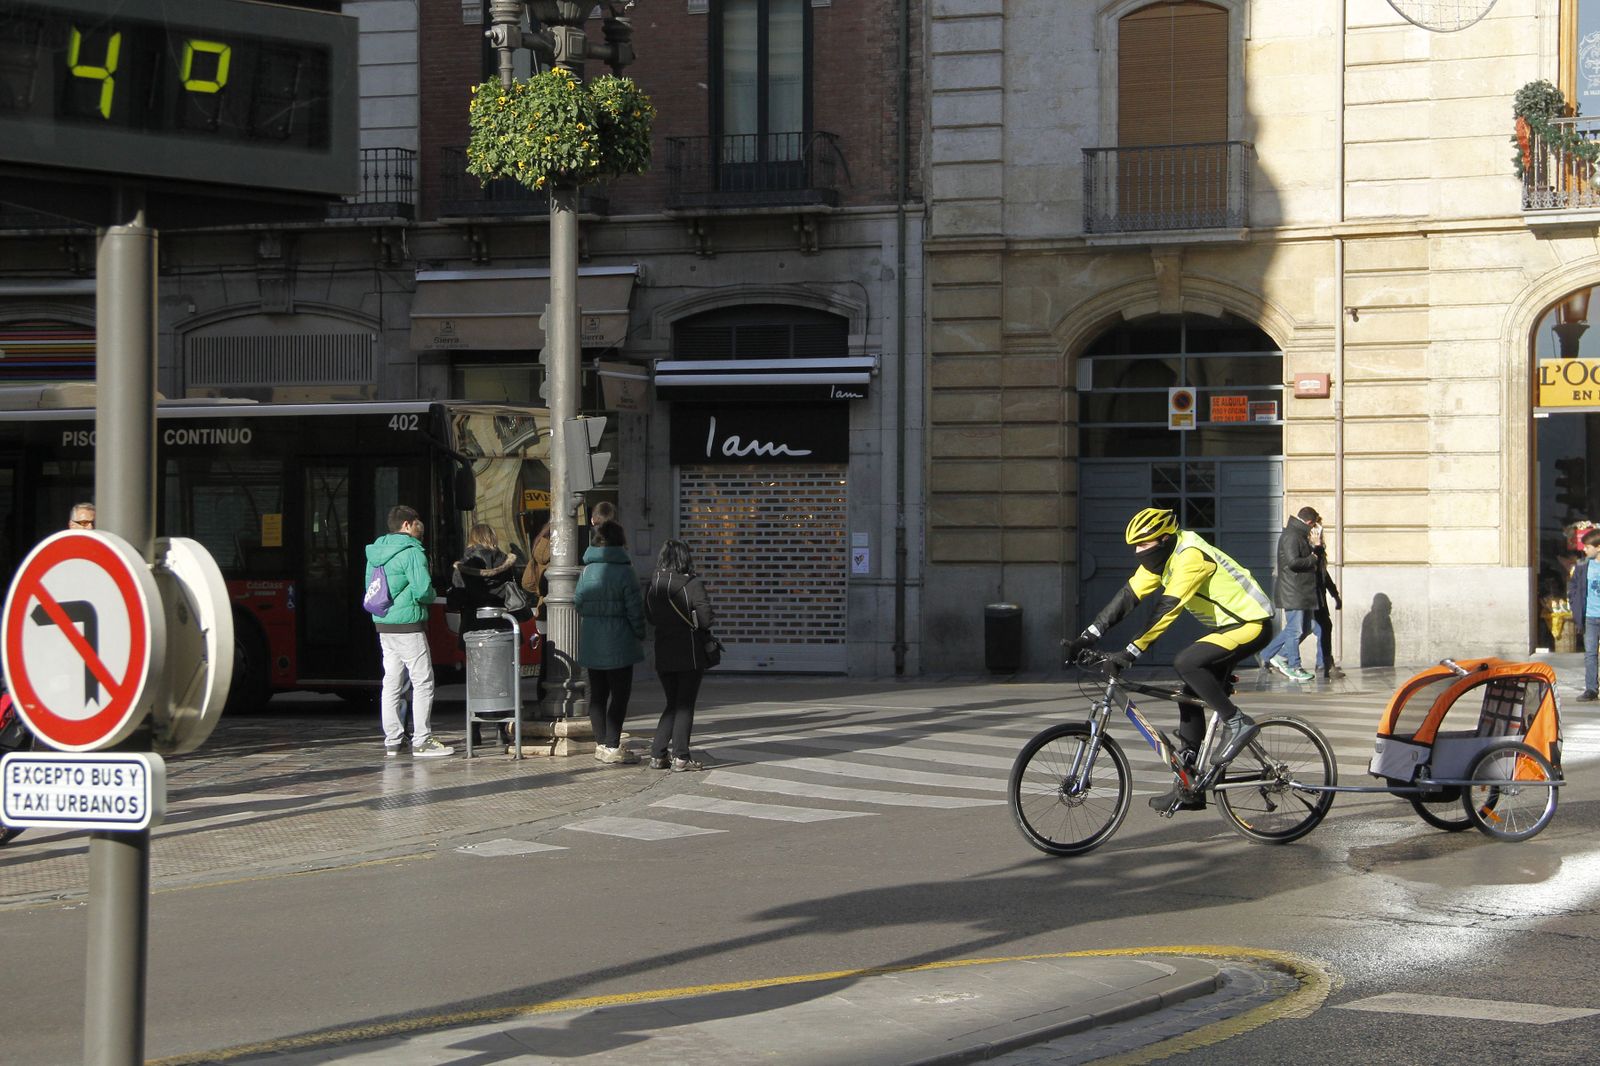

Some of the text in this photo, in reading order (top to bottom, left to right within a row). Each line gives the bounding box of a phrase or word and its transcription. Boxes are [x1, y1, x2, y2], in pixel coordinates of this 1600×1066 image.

[1573, 390, 1592, 401] EN
[388, 414, 419, 431] 402
[164, 428, 252, 445] CONTINUO
[13, 767, 138, 786] EXCEPTO BUS Y
[13, 793, 139, 814] TAXI URBANOS
